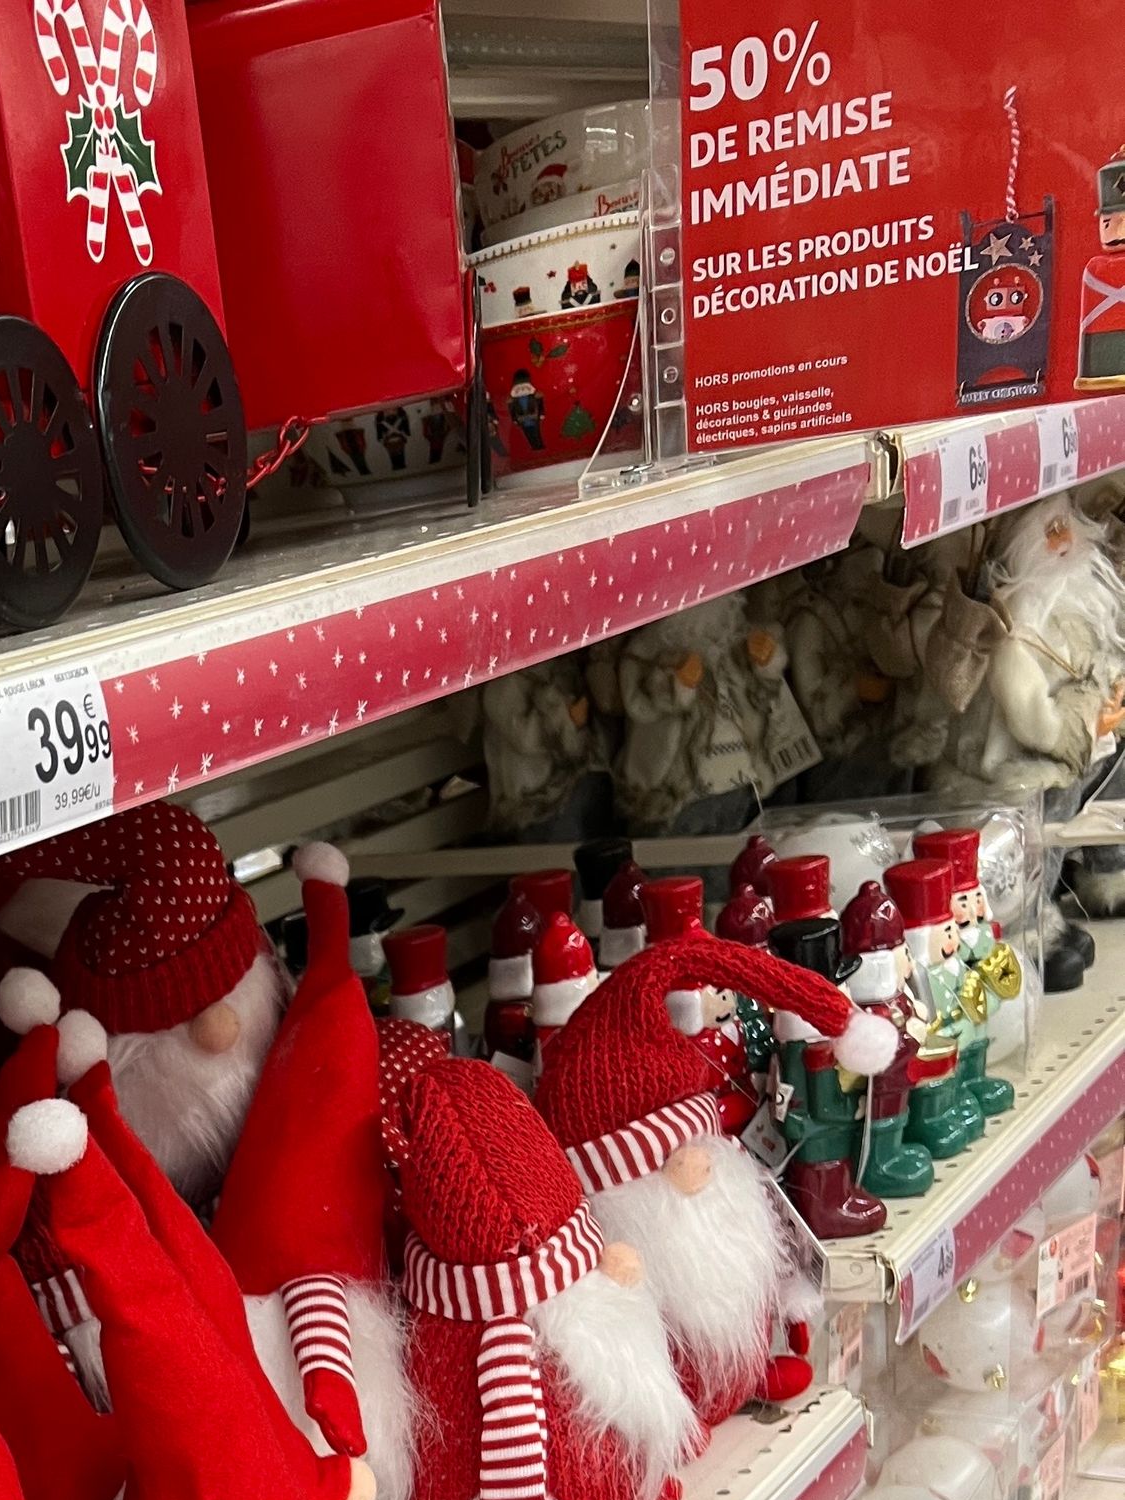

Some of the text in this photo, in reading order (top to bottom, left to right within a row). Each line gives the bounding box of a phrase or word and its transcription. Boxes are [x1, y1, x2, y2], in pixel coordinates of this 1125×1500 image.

[689, 20, 831, 112] 50%
[690, 91, 893, 168] DE REMISE
[691, 147, 911, 224] IMMÉDIATE
[692, 215, 934, 282] SUR LES PRODUITS
[693, 242, 979, 319] DÉCORATION DE NOËL
[695, 355, 848, 388] HORS promotions en cours
[696, 386, 834, 416] HORS bougies, vaisselle,
[696, 400, 832, 430] décorations & guirlandes
[696, 412, 852, 445] électriques, sapins artificiels
[54, 782, 101, 811] 39,99€/u
